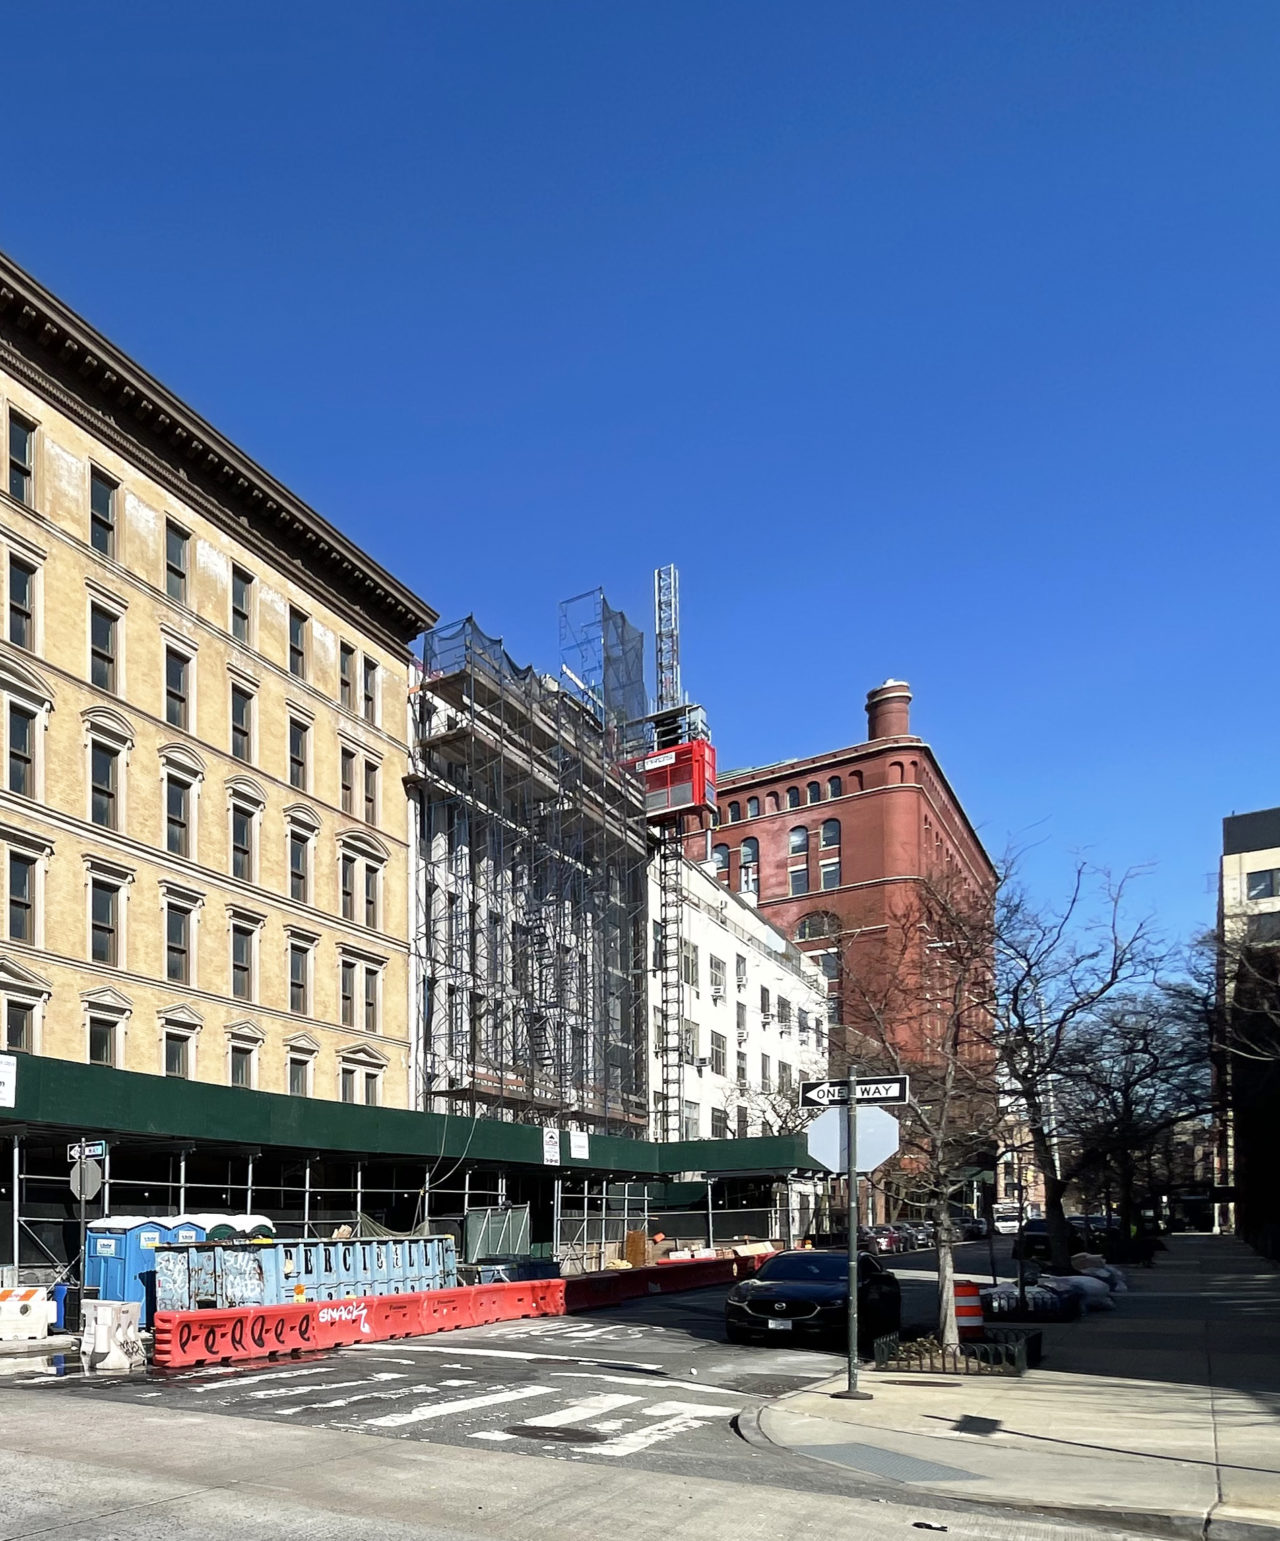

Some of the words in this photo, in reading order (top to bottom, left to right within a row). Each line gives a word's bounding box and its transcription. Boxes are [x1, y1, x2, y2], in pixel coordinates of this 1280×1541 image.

[817, 1087, 846, 1099] ONE
[860, 1085, 892, 1097] WAY
[318, 1301, 371, 1333] SNACK
